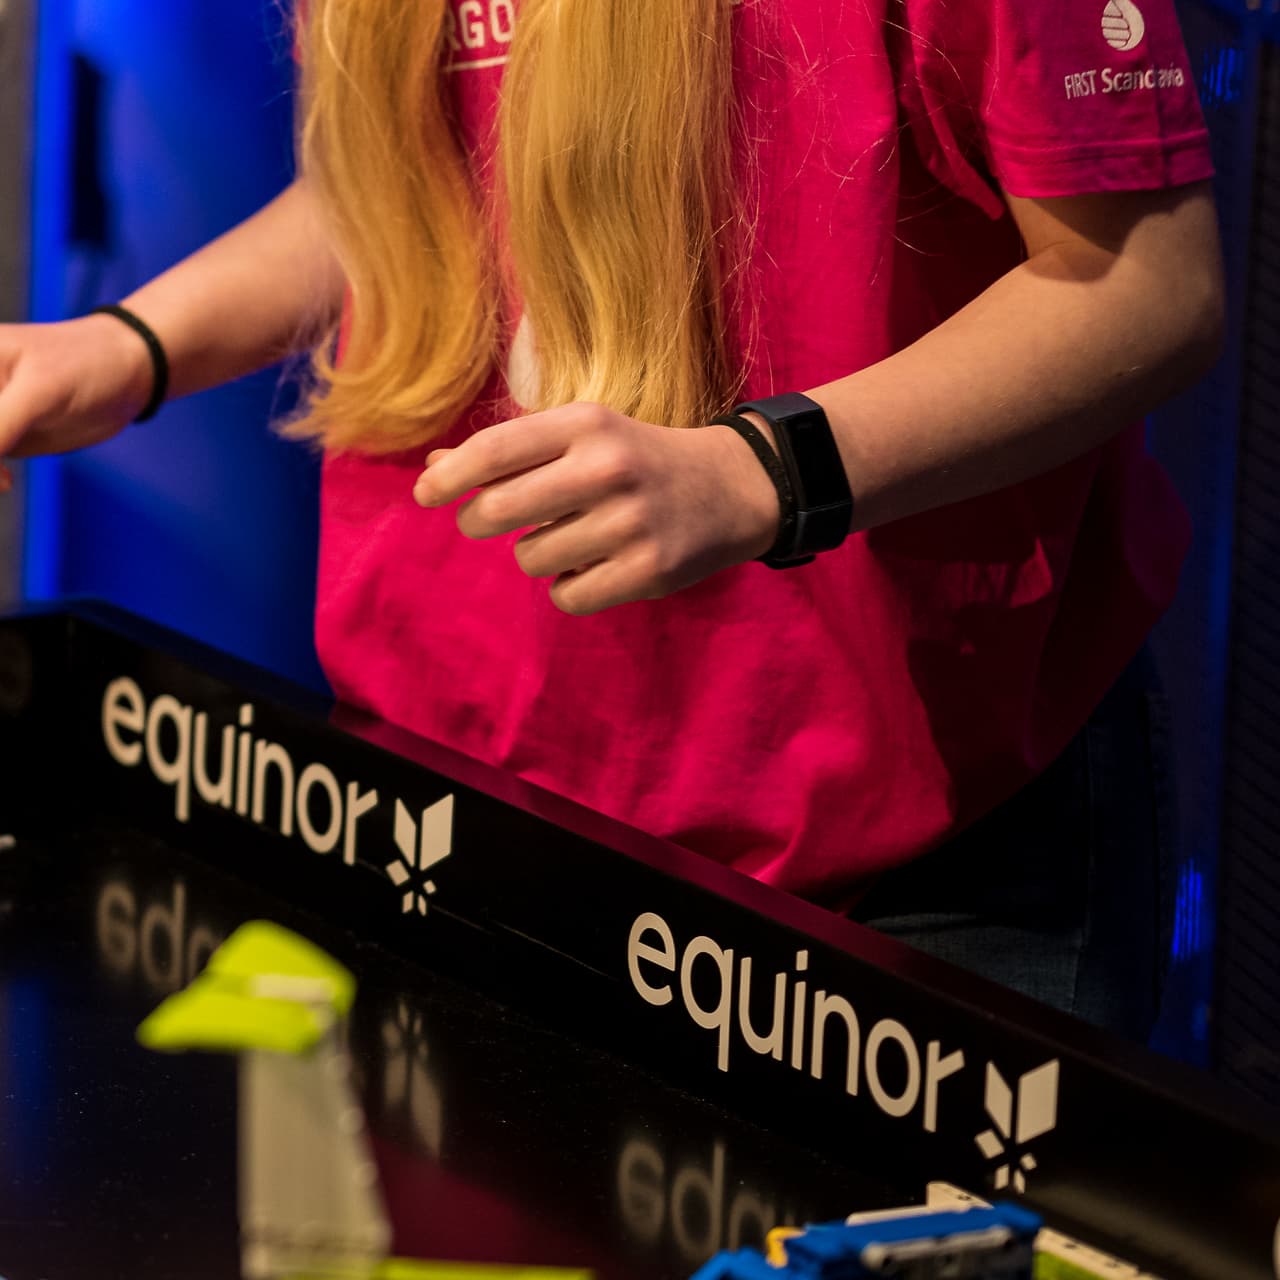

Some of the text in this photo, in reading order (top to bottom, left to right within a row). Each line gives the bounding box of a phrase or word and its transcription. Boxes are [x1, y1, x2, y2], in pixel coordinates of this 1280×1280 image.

[1064, 69, 1097, 100] FIRST
[101, 676, 378, 866] equinor
[627, 911, 965, 1132] equinor
